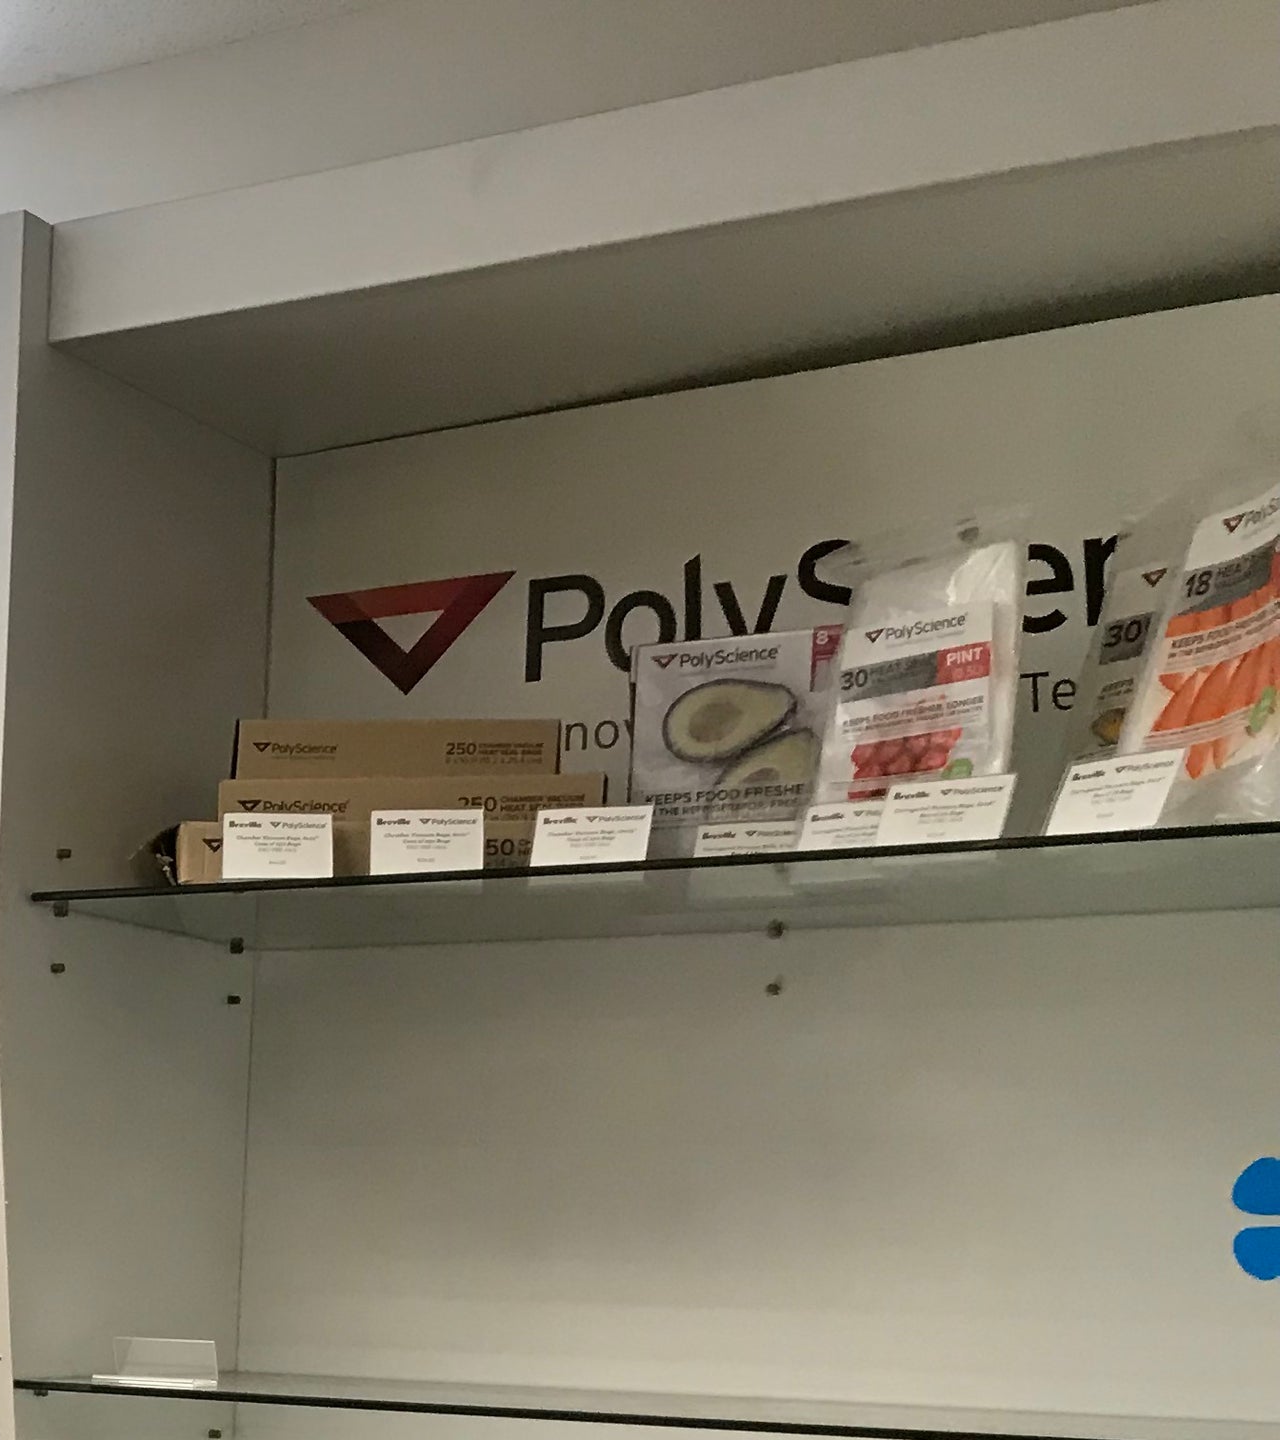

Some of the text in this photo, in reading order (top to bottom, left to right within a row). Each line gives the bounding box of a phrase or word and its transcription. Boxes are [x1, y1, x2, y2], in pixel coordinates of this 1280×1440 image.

[1185, 570, 1212, 598] 18
[885, 614, 966, 640] PolyScience
[1103, 619, 1141, 649] 30
[679, 646, 778, 668] PolyScience
[946, 647, 983, 665] PINT
[841, 669, 868, 690] 30
[271, 743, 337, 755] PolyScience
[446, 742, 477, 756] 250
[645, 783, 805, 805] KEEPS FOOD FRESHE
